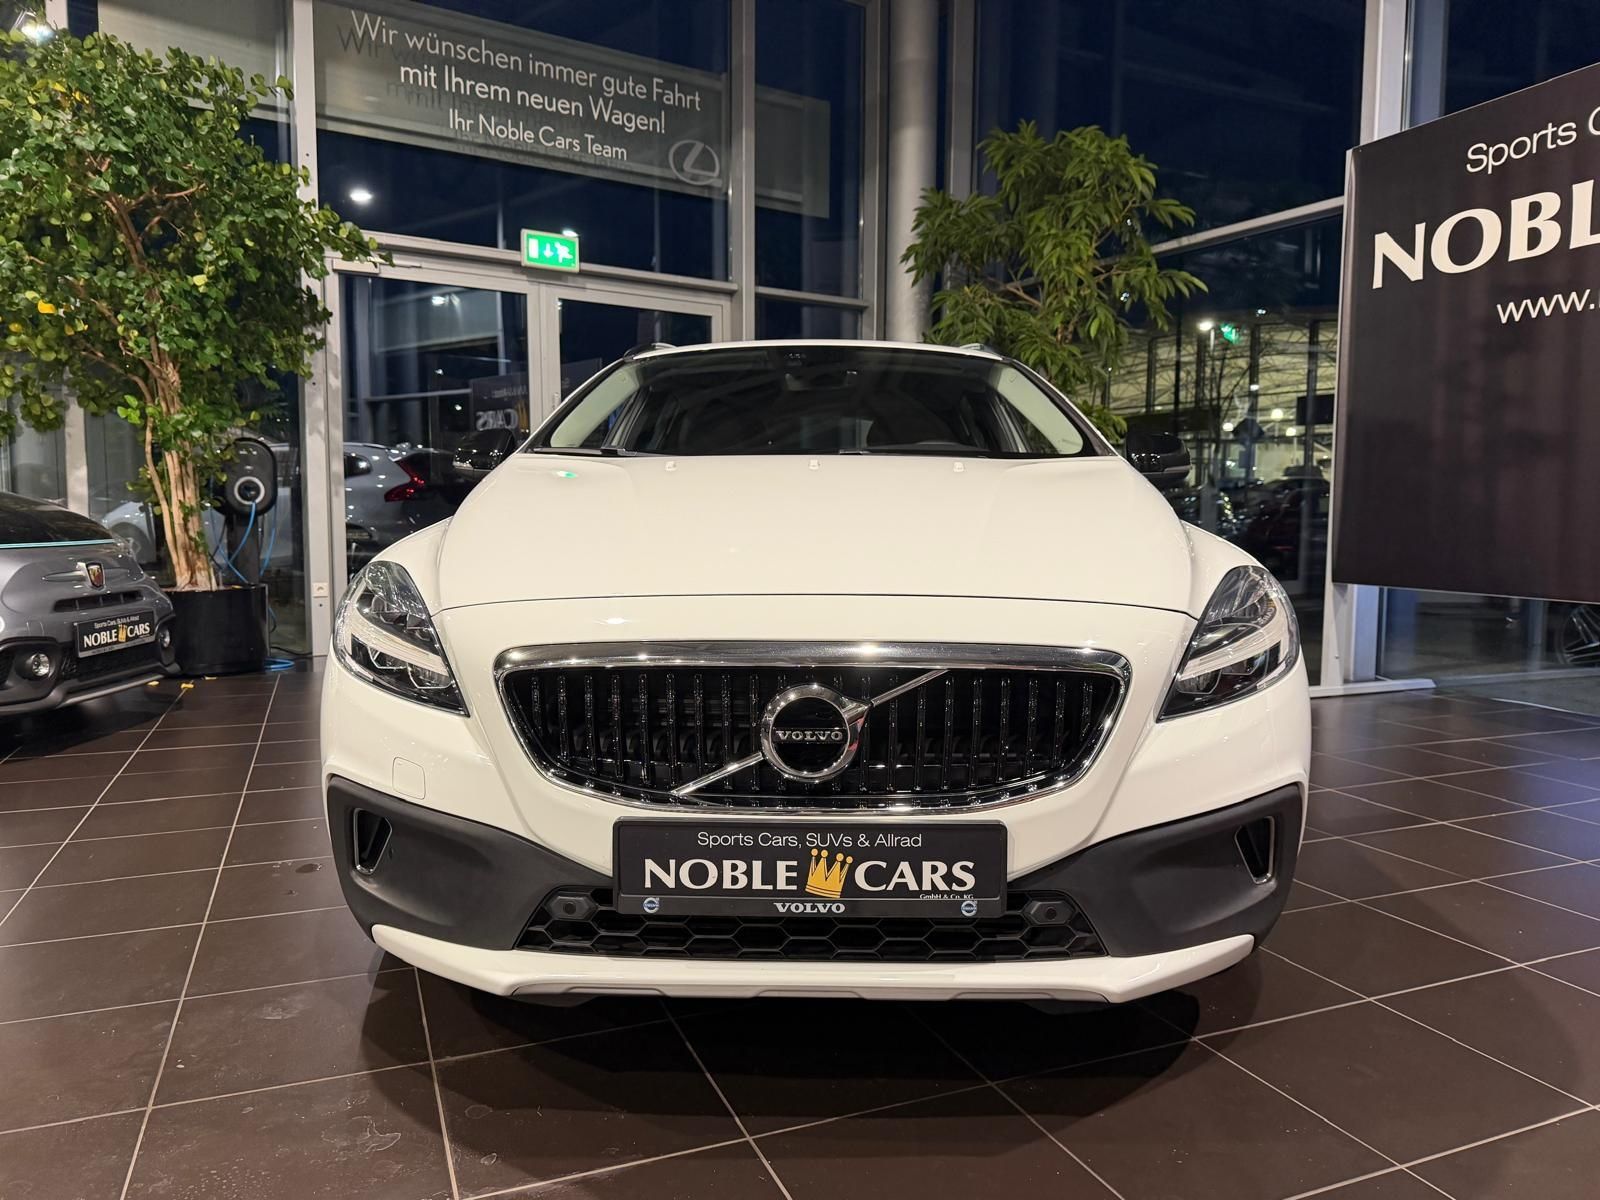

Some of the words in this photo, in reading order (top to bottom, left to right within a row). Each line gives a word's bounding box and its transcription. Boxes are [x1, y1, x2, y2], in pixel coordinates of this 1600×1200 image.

[351, 10, 399, 45] Wir
[404, 32, 523, 74] wünschen
[528, 53, 597, 88] immer
[602, 75, 648, 100] gute
[652, 77, 702, 112] Fahrt
[400, 64, 438, 89] mit
[444, 64, 511, 103] Ihrem
[516, 89, 584, 118] neuen
[588, 95, 666, 134] Wagen!
[449, 108, 475, 132] Ihr
[478, 113, 535, 143] Noble
[538, 125, 581, 152] Cars
[584, 133, 628, 161] Team
[1465, 121, 1578, 175] Sports
[1372, 179, 1600, 290] NOBL
[1496, 288, 1600, 324] www.
[83, 629, 118, 648] NOBLE
[127, 622, 150, 637] CARS
[776, 730, 843, 741] VOLVO
[697, 831, 754, 848] Sports
[758, 832, 802, 848] Cars,
[806, 832, 853, 847] SUVs
[857, 833, 871, 847] &
[874, 833, 922, 847] Allrad
[643, 858, 798, 891] NOBLE
[854, 860, 976, 892] CARS
[773, 902, 846, 914] VOLVO
